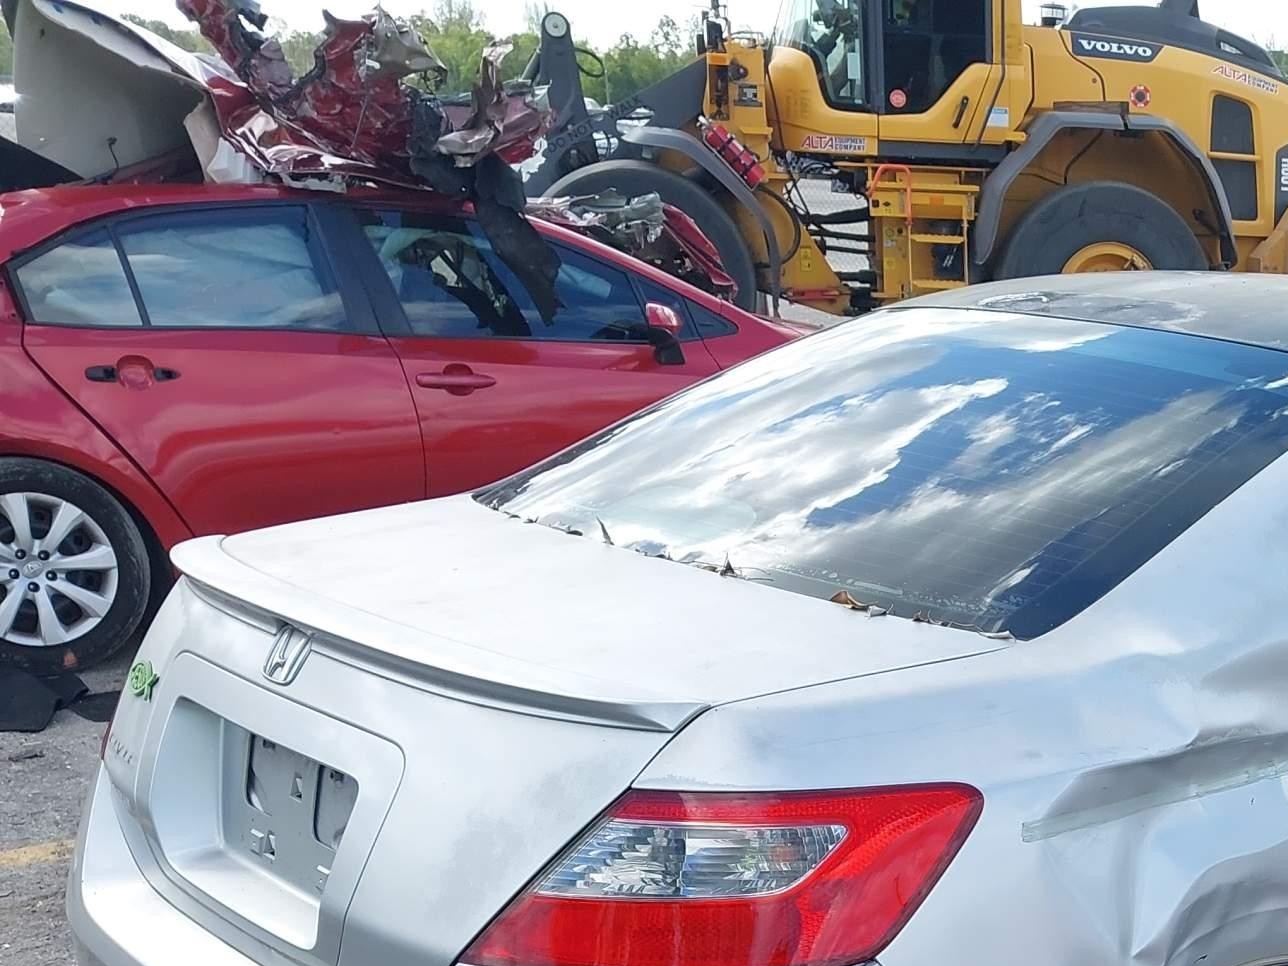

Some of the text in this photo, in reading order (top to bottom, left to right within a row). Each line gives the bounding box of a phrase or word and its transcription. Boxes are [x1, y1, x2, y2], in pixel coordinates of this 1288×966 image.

[1078, 39, 1152, 57] VOLVO
[1212, 65, 1249, 83] ALTA
[801, 136, 834, 149] ALTA
